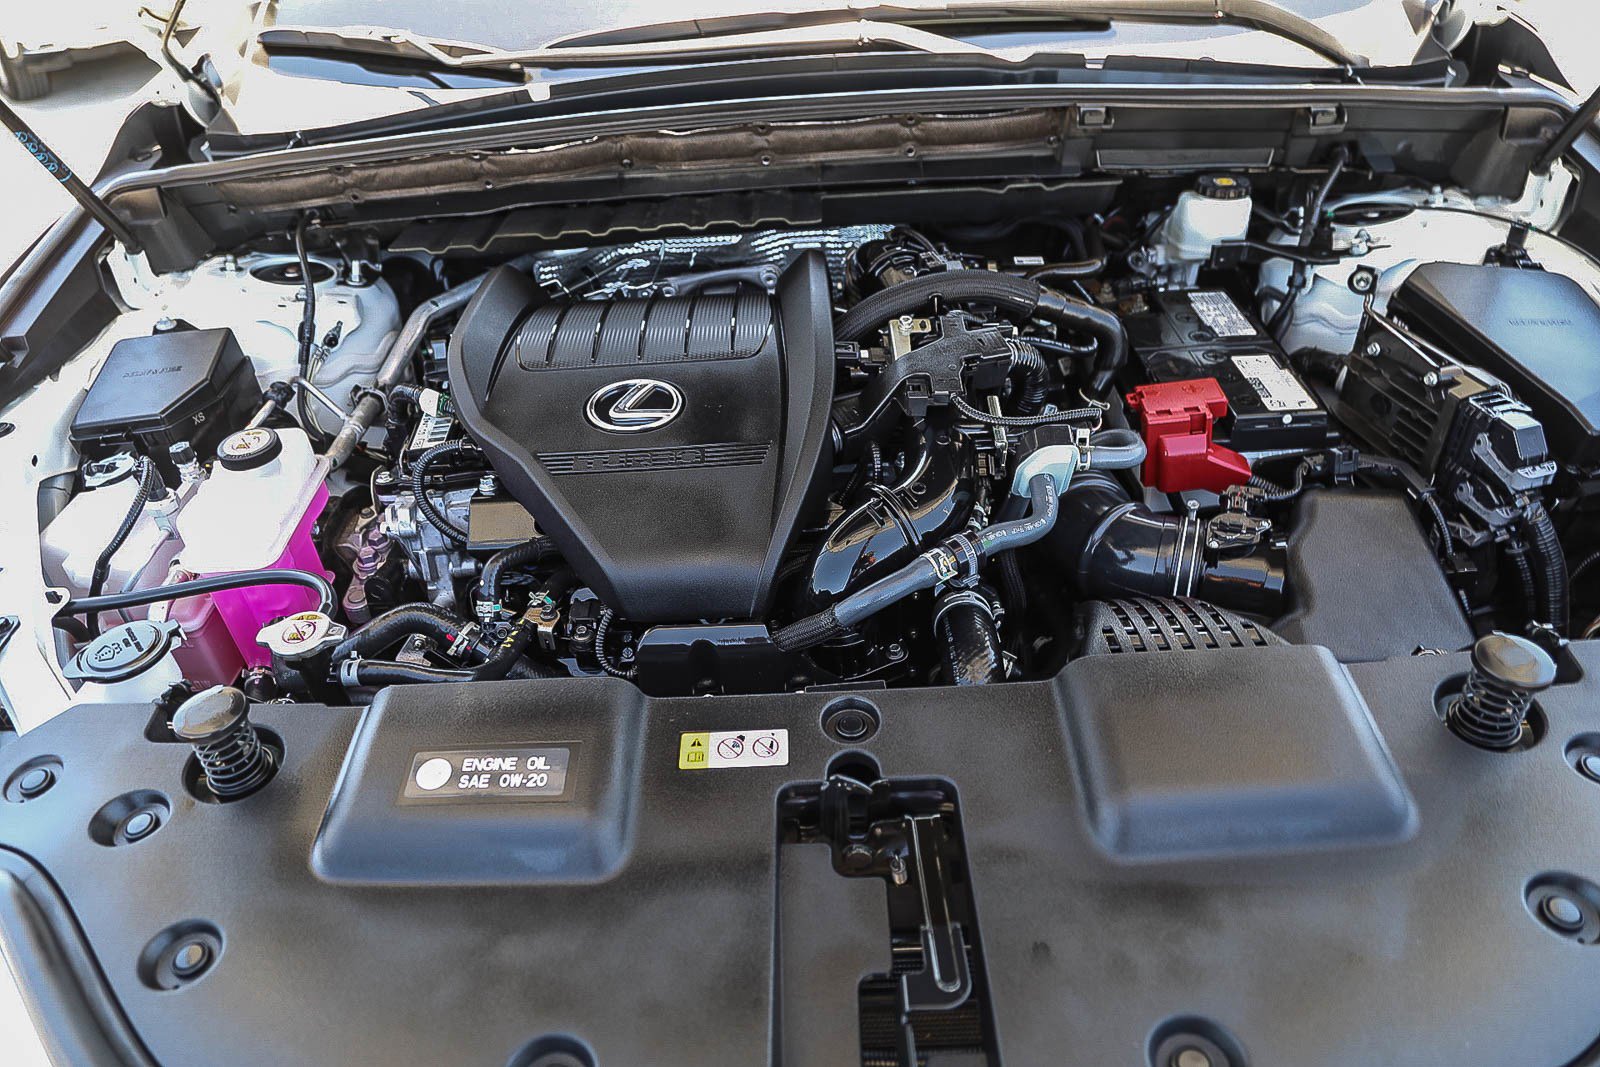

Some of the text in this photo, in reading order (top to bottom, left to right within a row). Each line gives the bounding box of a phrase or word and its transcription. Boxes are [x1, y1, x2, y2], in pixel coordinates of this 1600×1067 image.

[573, 450, 702, 468] TURBO
[461, 756, 551, 772] ENGINE OIL
[458, 774, 491, 789] SAE
